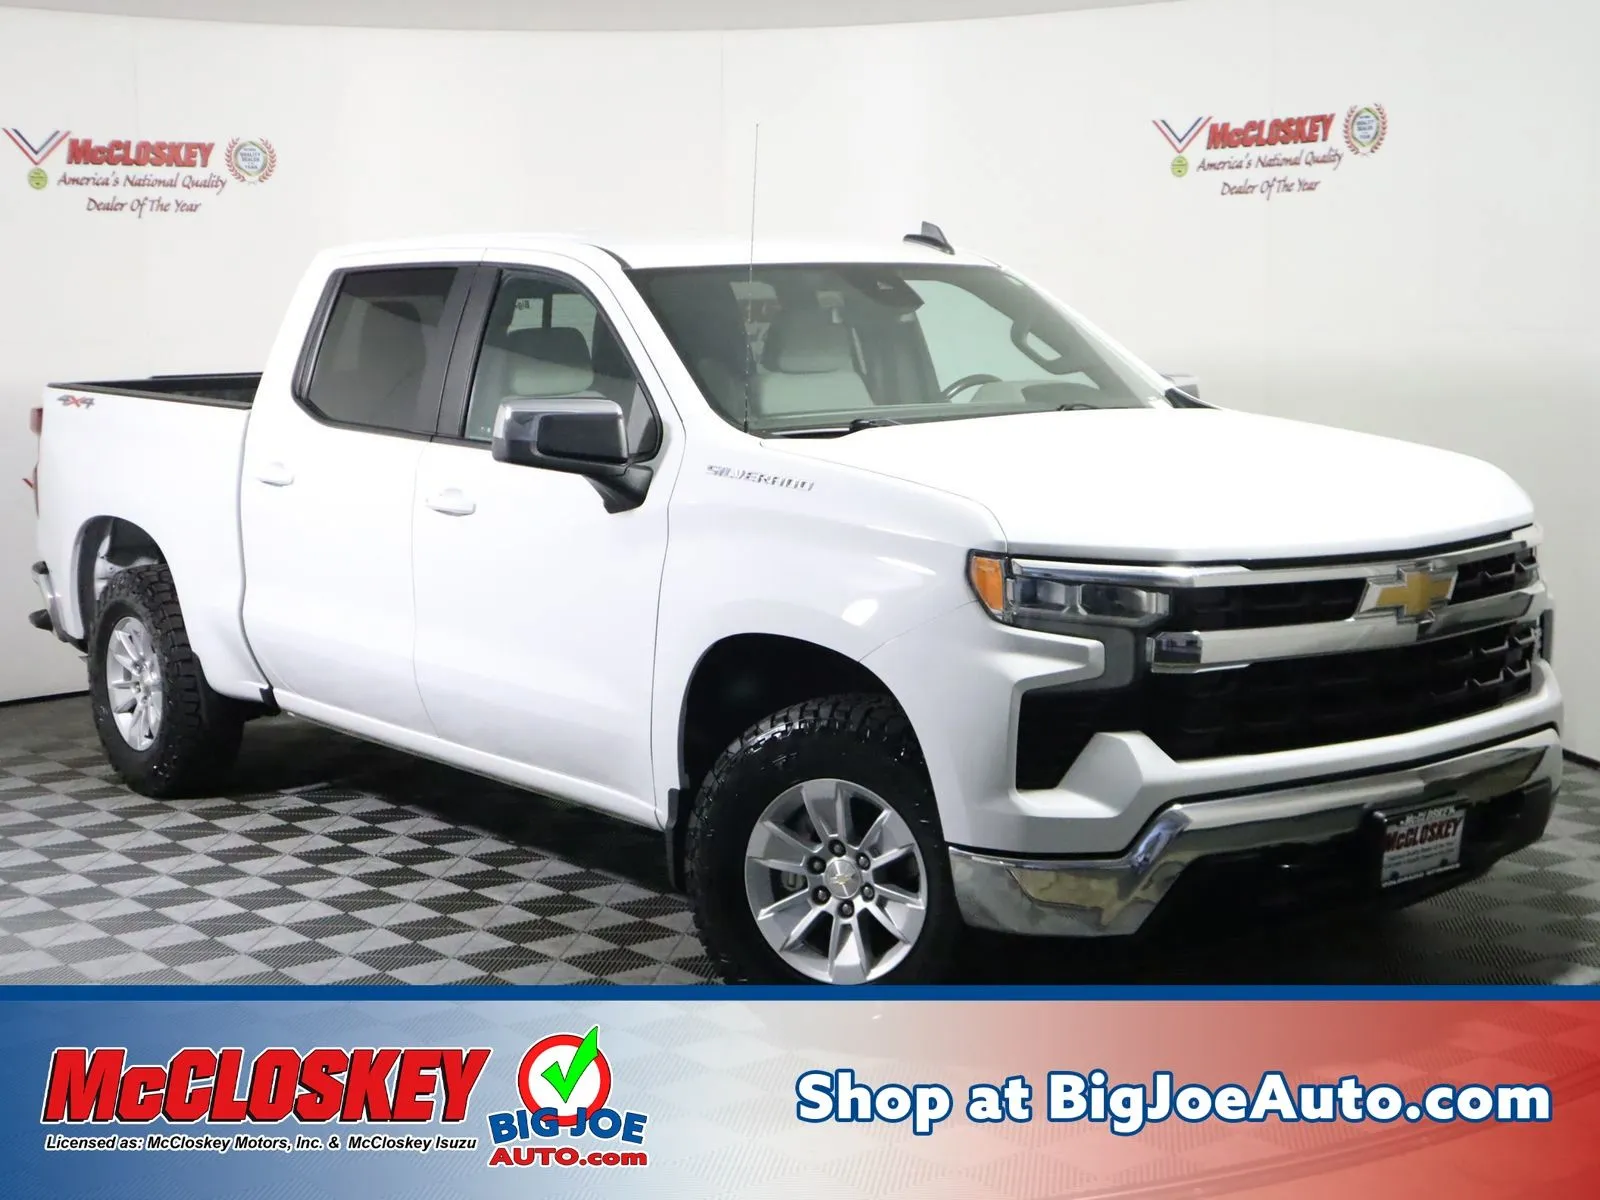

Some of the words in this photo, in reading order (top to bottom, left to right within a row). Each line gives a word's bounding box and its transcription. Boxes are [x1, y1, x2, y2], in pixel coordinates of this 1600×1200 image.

[1206, 113, 1336, 150] McCLOSKEY
[67, 138, 215, 168] McCLOSKEY
[1196, 152, 1252, 172] America's
[1255, 149, 1304, 169] National
[1305, 146, 1344, 171] Quality
[56, 171, 119, 187] America's
[123, 172, 179, 188] National
[181, 173, 227, 195] Quality
[1221, 178, 1259, 195] Dealer
[1260, 176, 1277, 201] Of
[1277, 176, 1295, 193] The
[1297, 178, 1321, 193] Year
[86, 196, 127, 212] Dealer
[130, 196, 148, 219] Of
[149, 198, 171, 213] The
[174, 199, 202, 213] Year
[706, 464, 814, 492] SILVERADO
